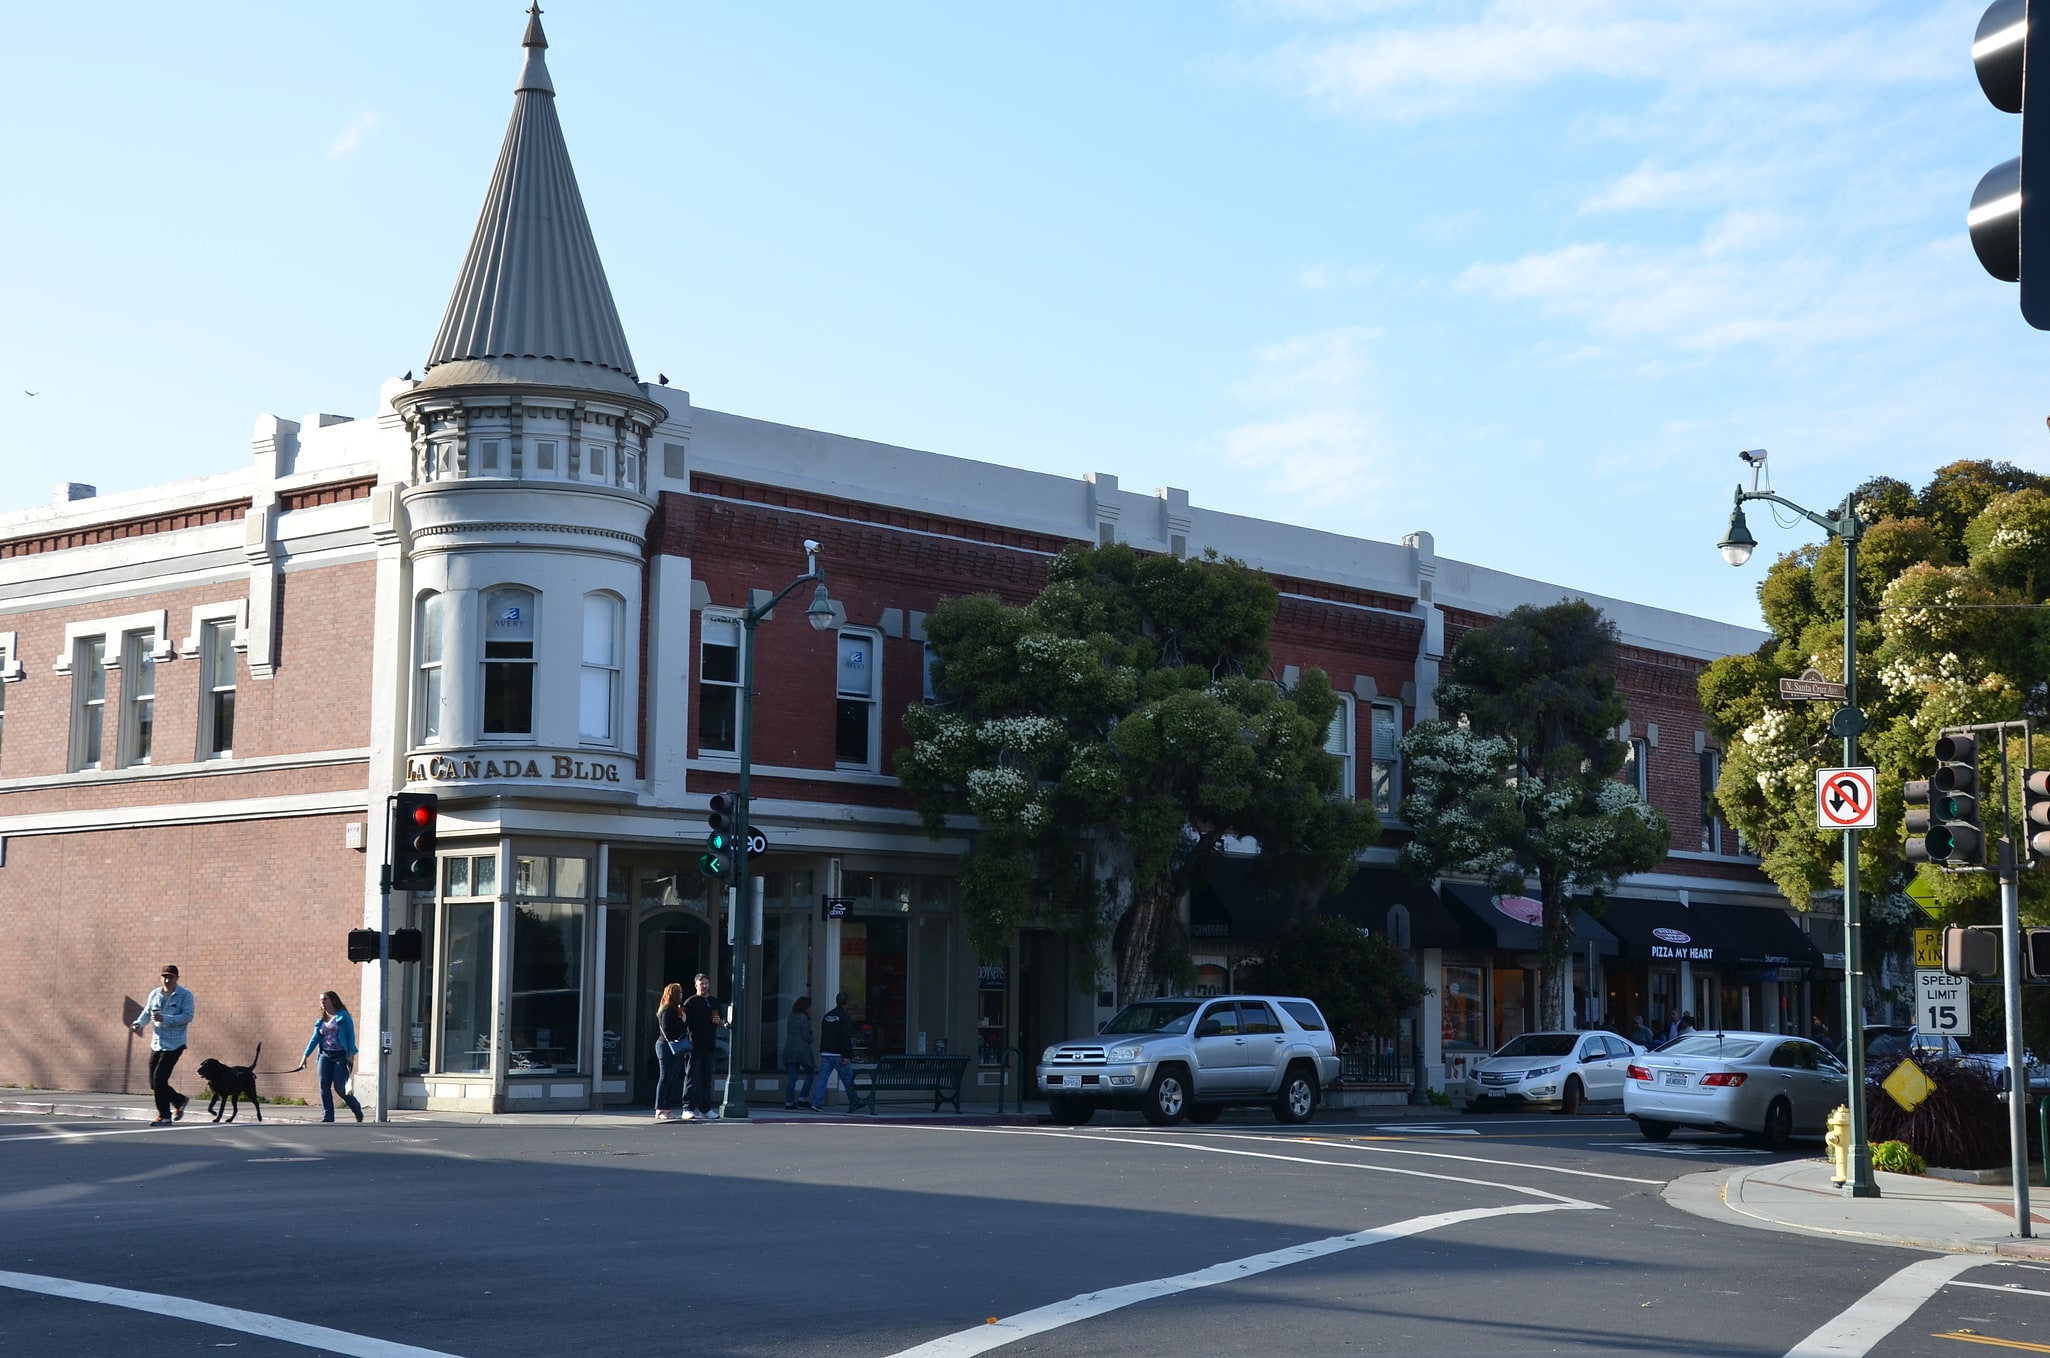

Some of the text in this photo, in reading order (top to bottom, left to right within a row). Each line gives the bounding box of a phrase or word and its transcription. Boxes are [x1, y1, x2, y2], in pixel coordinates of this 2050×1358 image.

[1794, 682, 1812, 693] Santa
[1813, 684, 1827, 694] Cruz
[1926, 934, 1943, 946] PE
[1651, 945, 1713, 960] PIZZA MY HEART
[1918, 950, 1942, 961] XIN
[1922, 976, 1963, 986] SPEED
[1927, 990, 1957, 999] LIMIT
[1928, 1006, 1958, 1029] 15
